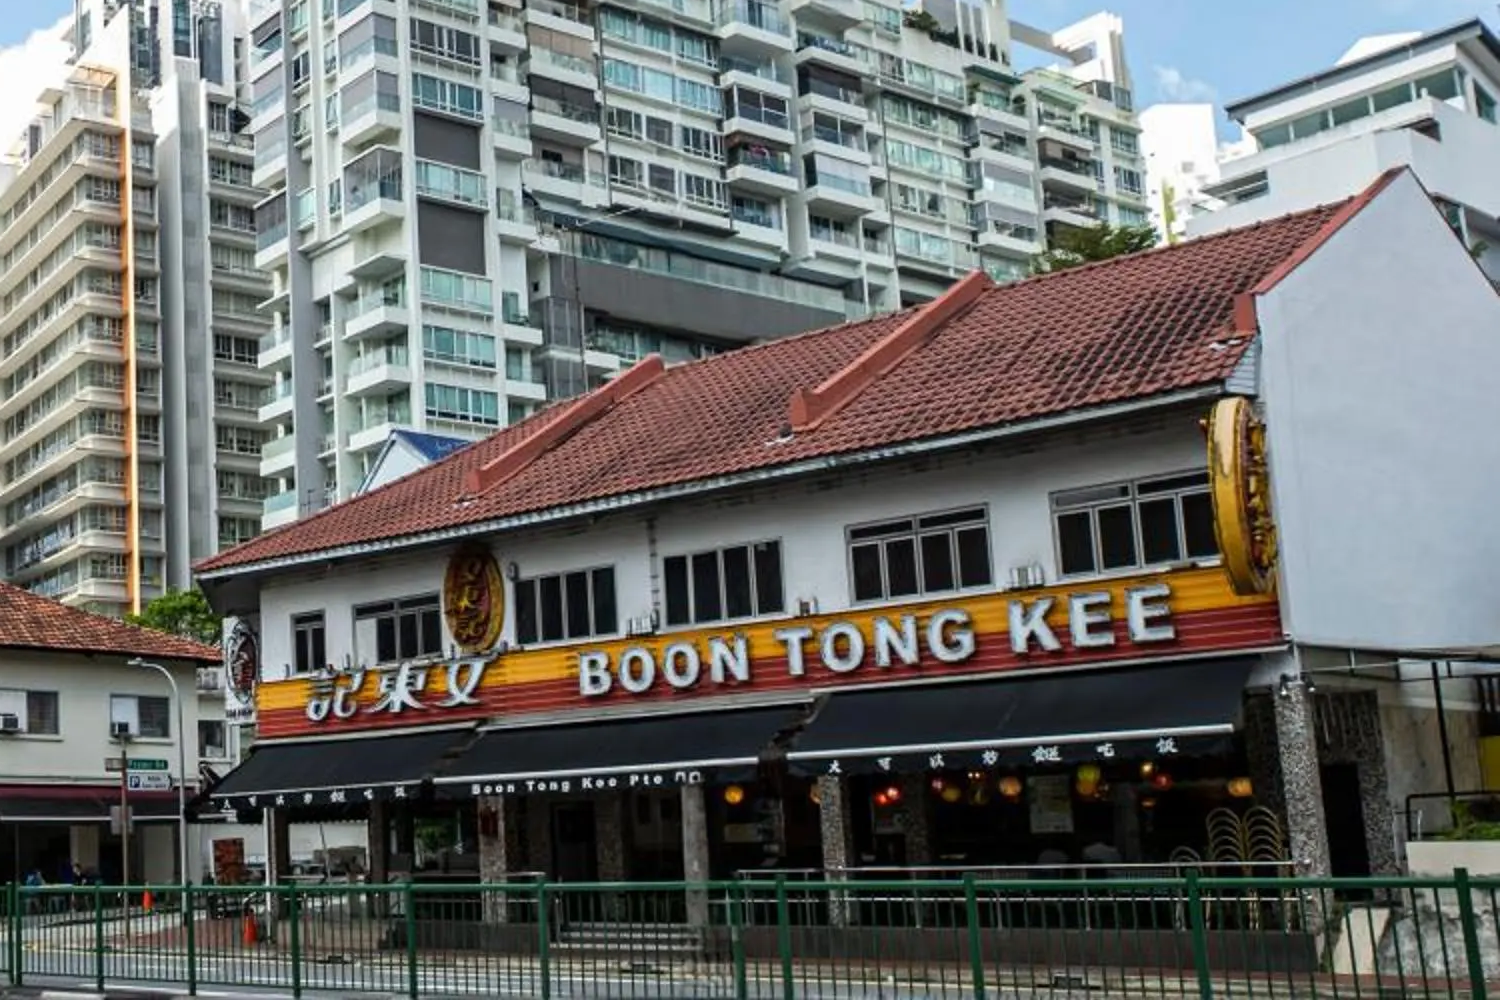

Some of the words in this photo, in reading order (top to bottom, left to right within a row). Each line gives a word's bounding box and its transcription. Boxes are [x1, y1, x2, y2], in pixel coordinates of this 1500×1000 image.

[577, 633, 751, 698] BOON
[775, 608, 978, 676] TONG
[1007, 582, 1177, 655] KEE
[471, 783, 516, 795] Boon
[525, 779, 571, 793] Tong
[581, 776, 618, 789] Kee
